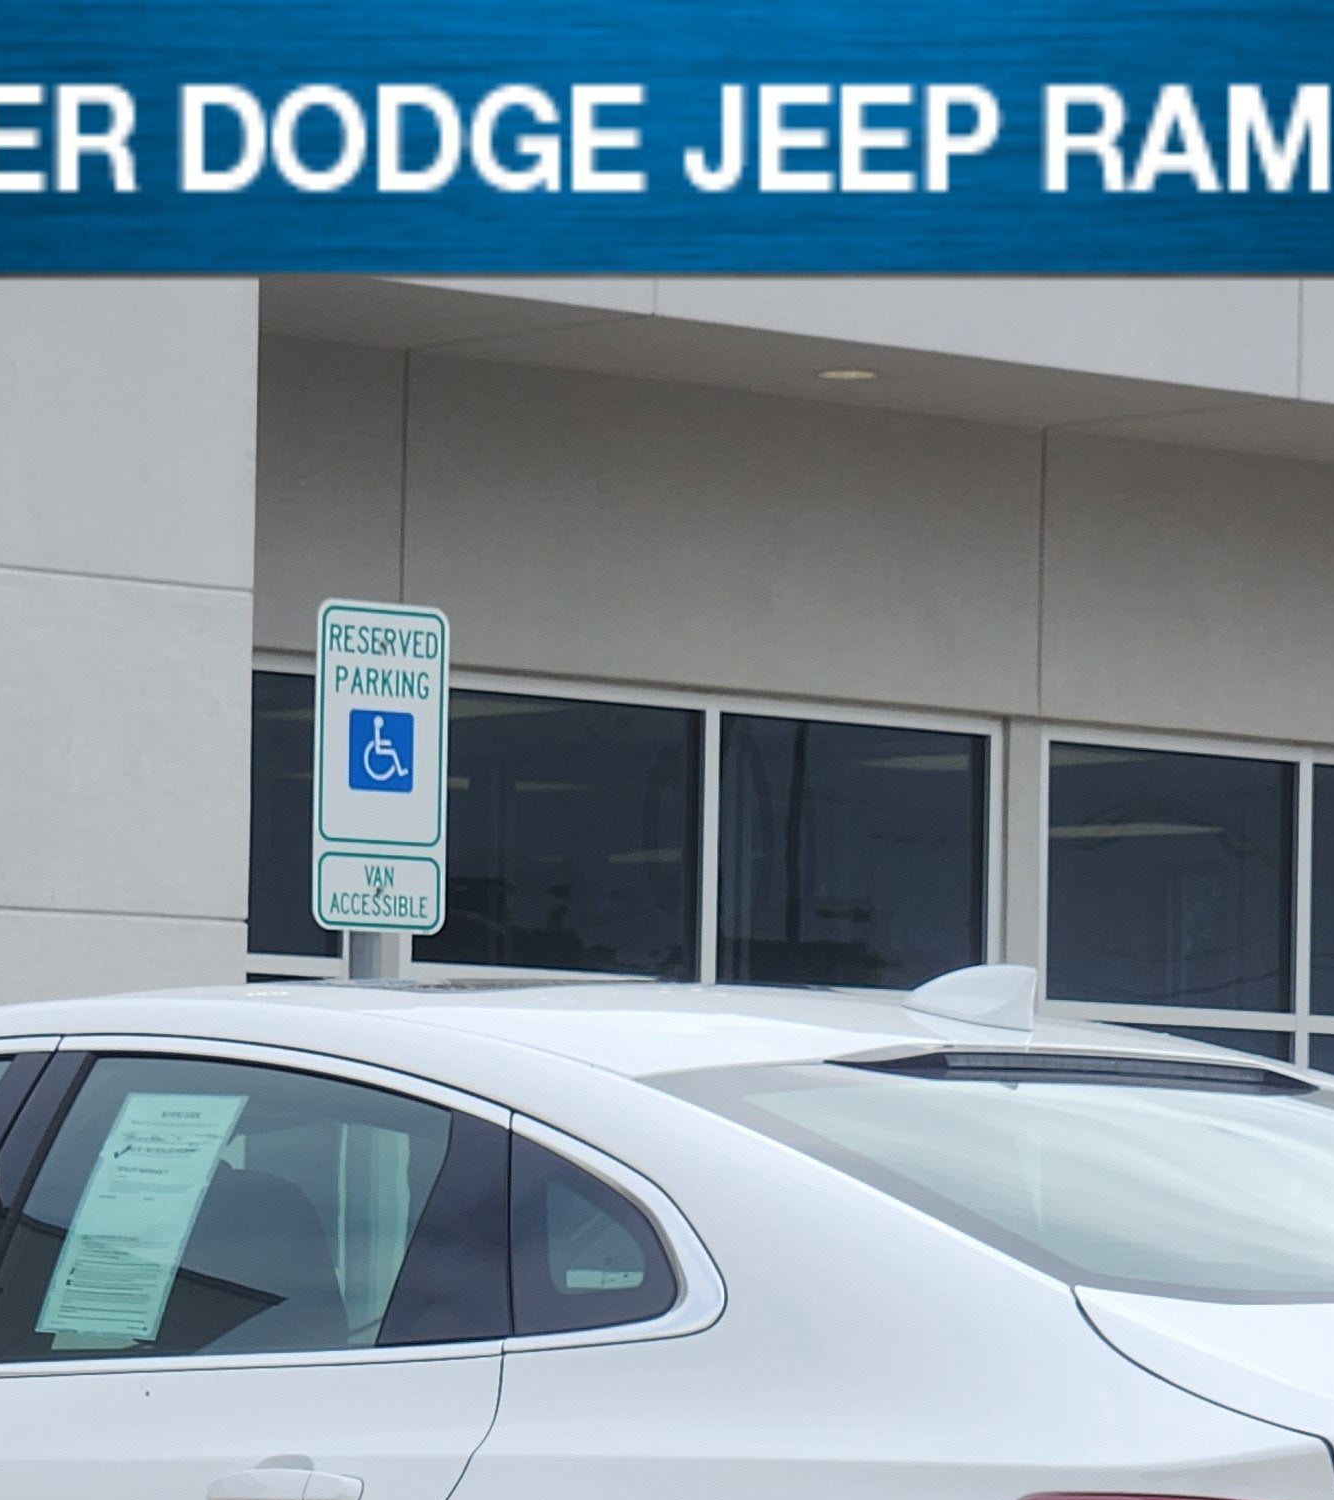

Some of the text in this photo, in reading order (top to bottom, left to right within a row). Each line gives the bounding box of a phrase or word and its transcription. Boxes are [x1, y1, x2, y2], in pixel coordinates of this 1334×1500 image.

[328, 623, 438, 660] RESERVED
[335, 665, 430, 700] PARKING
[364, 864, 395, 888] VAN
[330, 892, 428, 919] ACCESSIBLE
